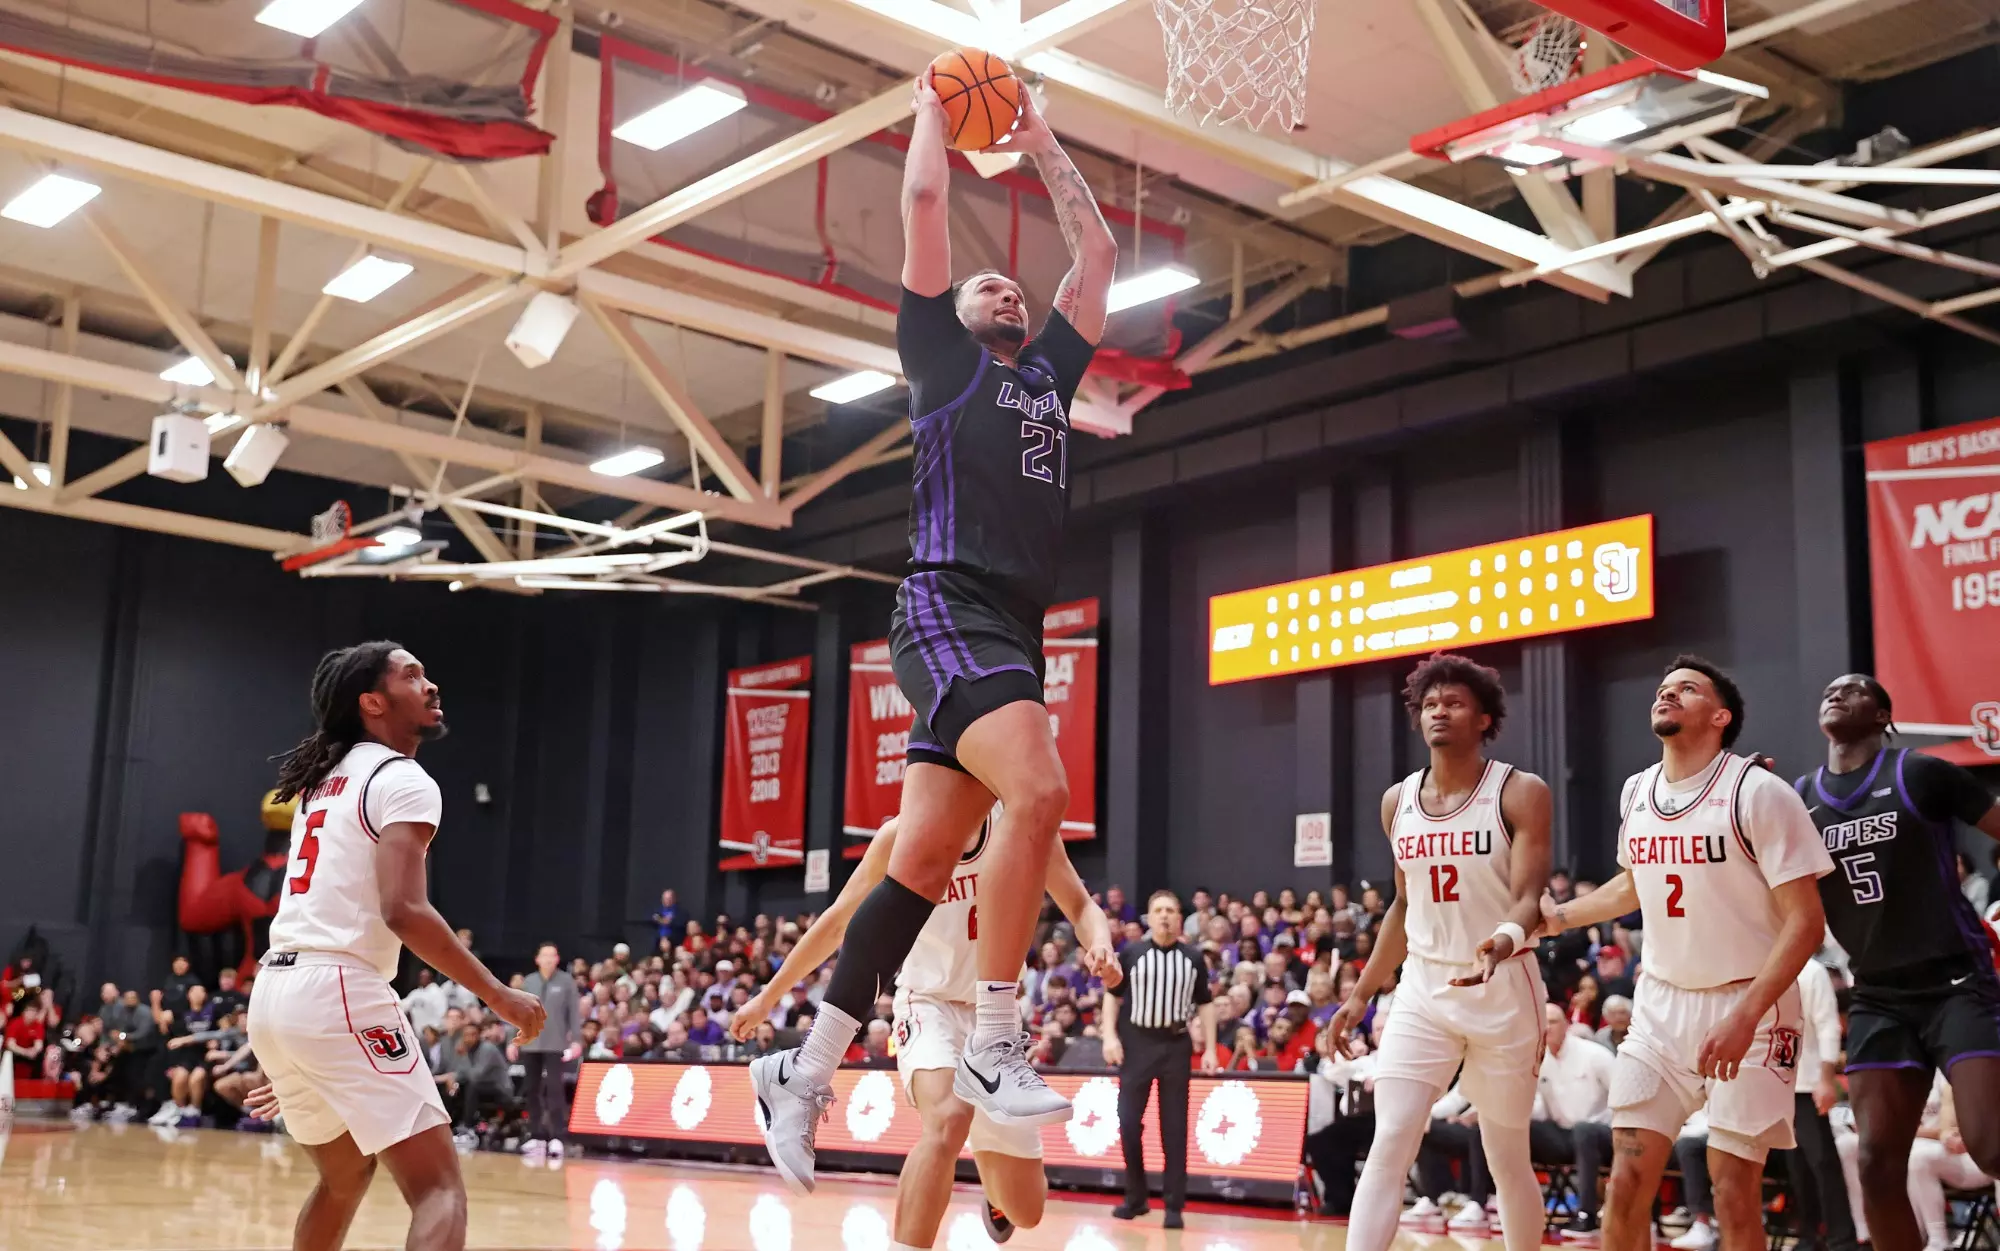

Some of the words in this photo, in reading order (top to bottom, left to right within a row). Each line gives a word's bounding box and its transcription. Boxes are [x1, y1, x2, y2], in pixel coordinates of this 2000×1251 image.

[1021, 420, 1066, 489] 21
[1907, 436, 1957, 467] MEN'S
[1942, 538, 1990, 568] FINAL
[290, 809, 328, 896] 5
[1429, 864, 1460, 903] 12
[1666, 873, 1686, 918] 2
[1840, 852, 1885, 905] 5
